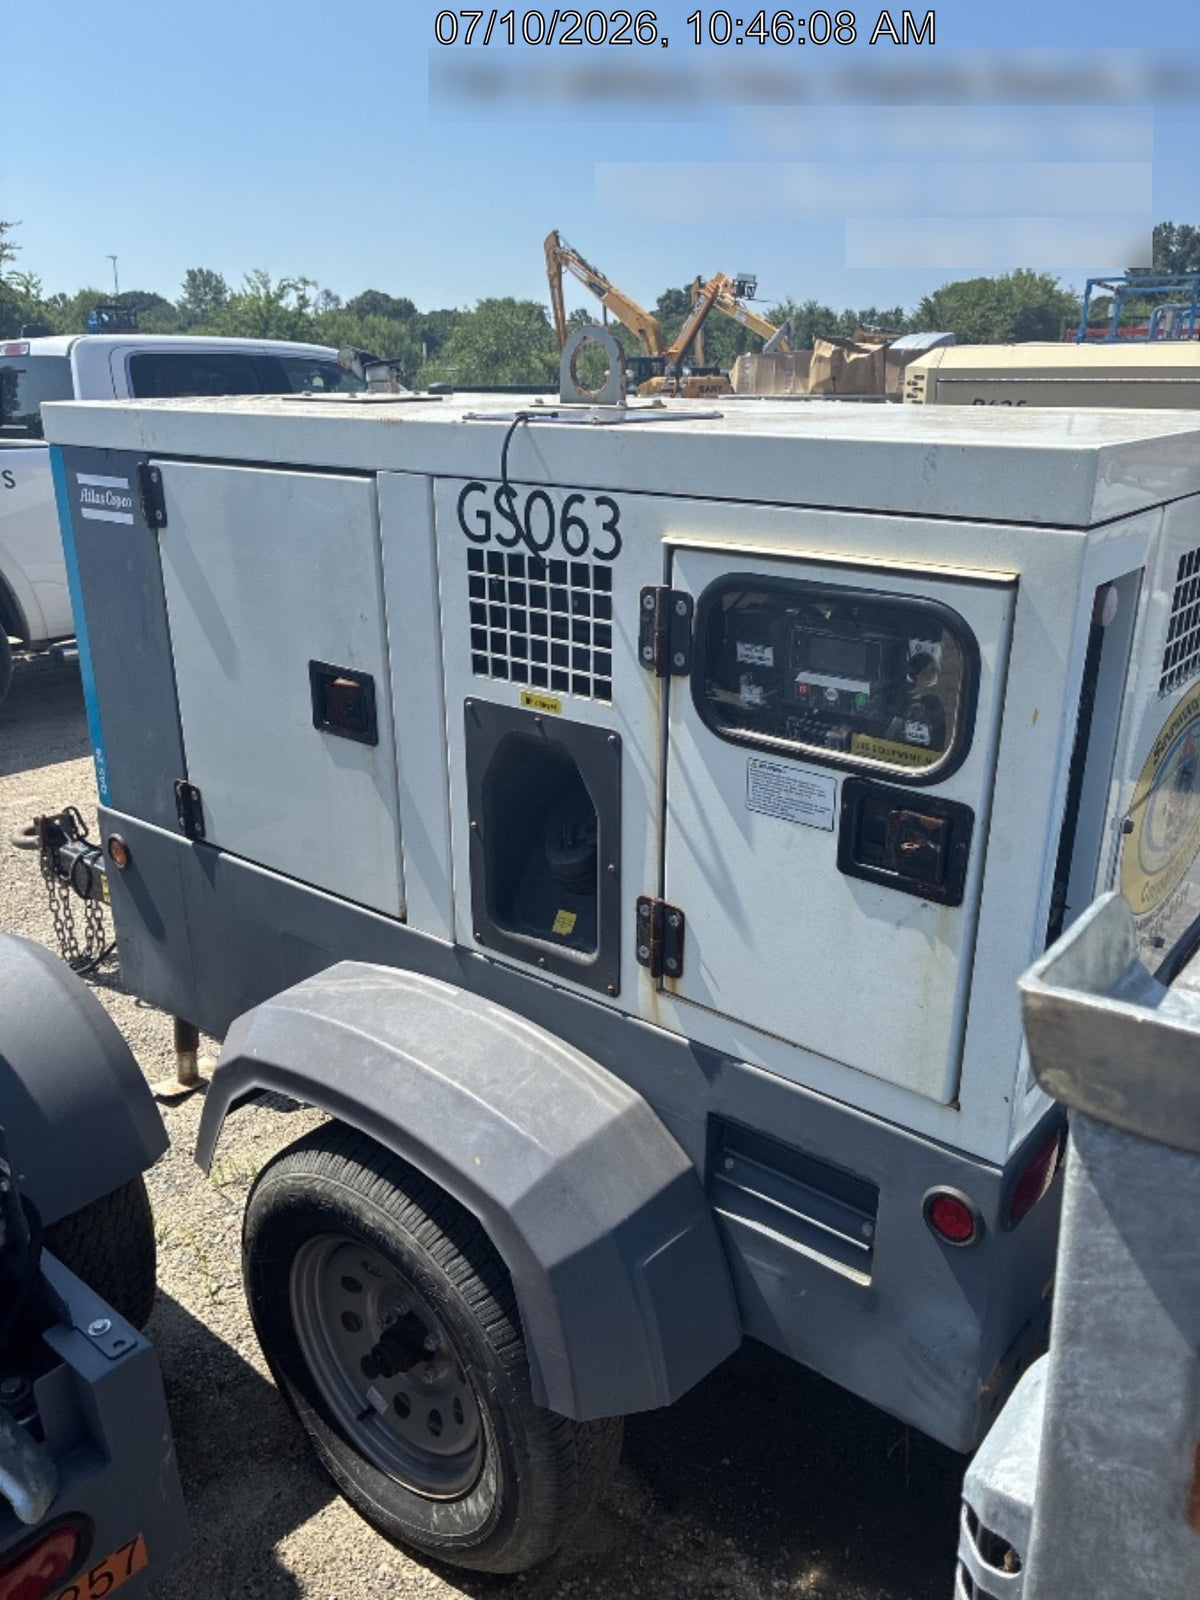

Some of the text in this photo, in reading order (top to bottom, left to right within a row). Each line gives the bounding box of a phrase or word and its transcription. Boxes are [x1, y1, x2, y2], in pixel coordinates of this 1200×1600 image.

[80, 489, 132, 509] Atlas Copco
[457, 482, 622, 561] GS063
